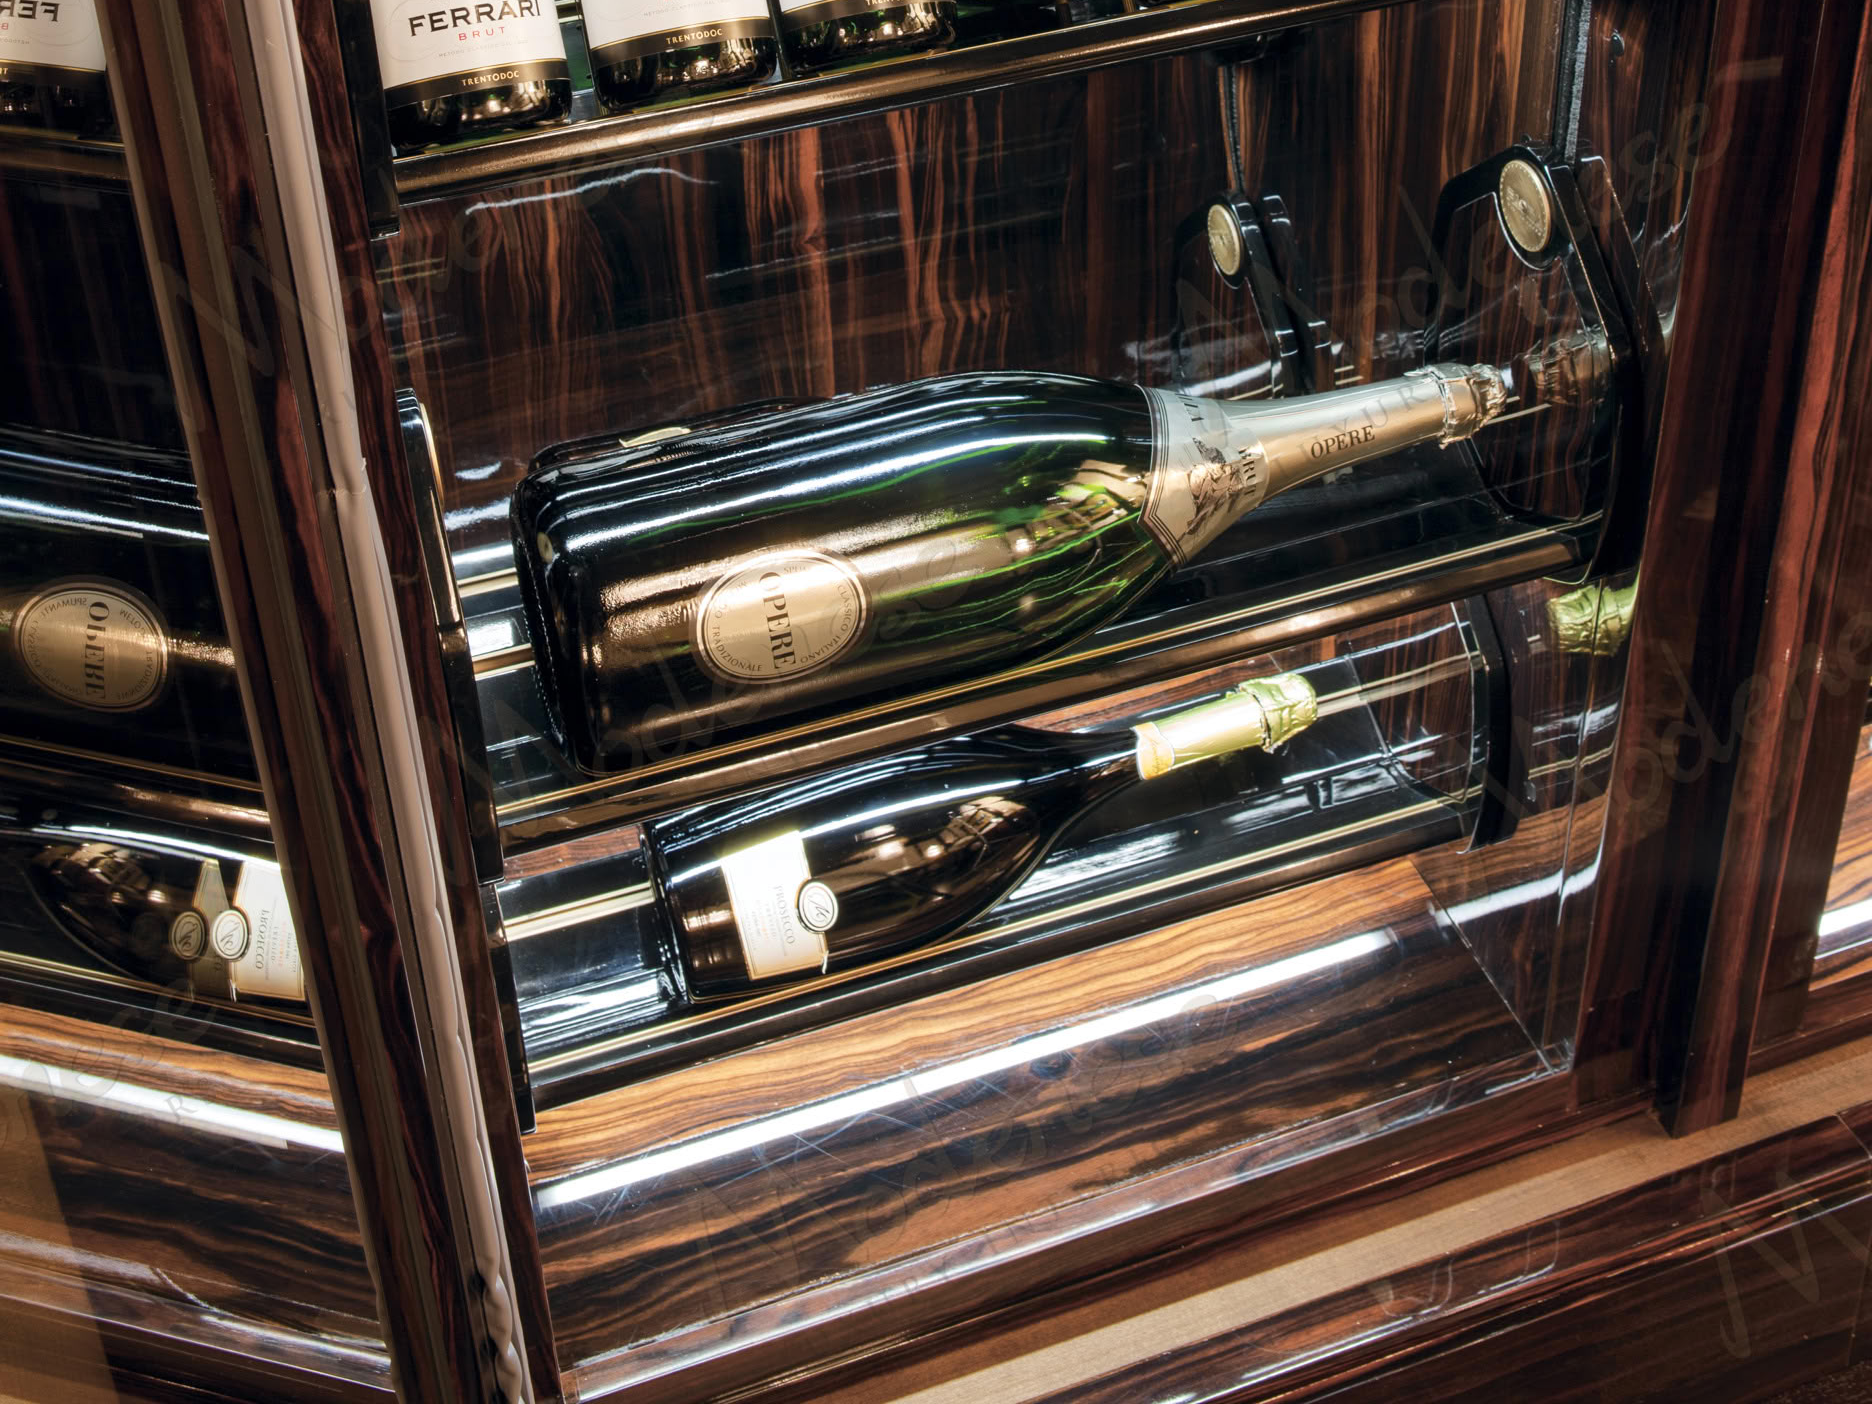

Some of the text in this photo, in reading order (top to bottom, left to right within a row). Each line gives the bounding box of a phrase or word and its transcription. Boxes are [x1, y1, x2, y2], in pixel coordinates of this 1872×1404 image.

[458, 26, 505, 41] BRUT
[665, 27, 723, 45] TRENTODOC
[461, 70, 520, 87] TRENTODOC
[1310, 424, 1376, 460] OPERE
[759, 571, 797, 670] OPERE
[837, 583, 853, 632] CLASSICO
[711, 625, 763, 673] TRADIZIONALE
[799, 635, 842, 664] ITALIANO
